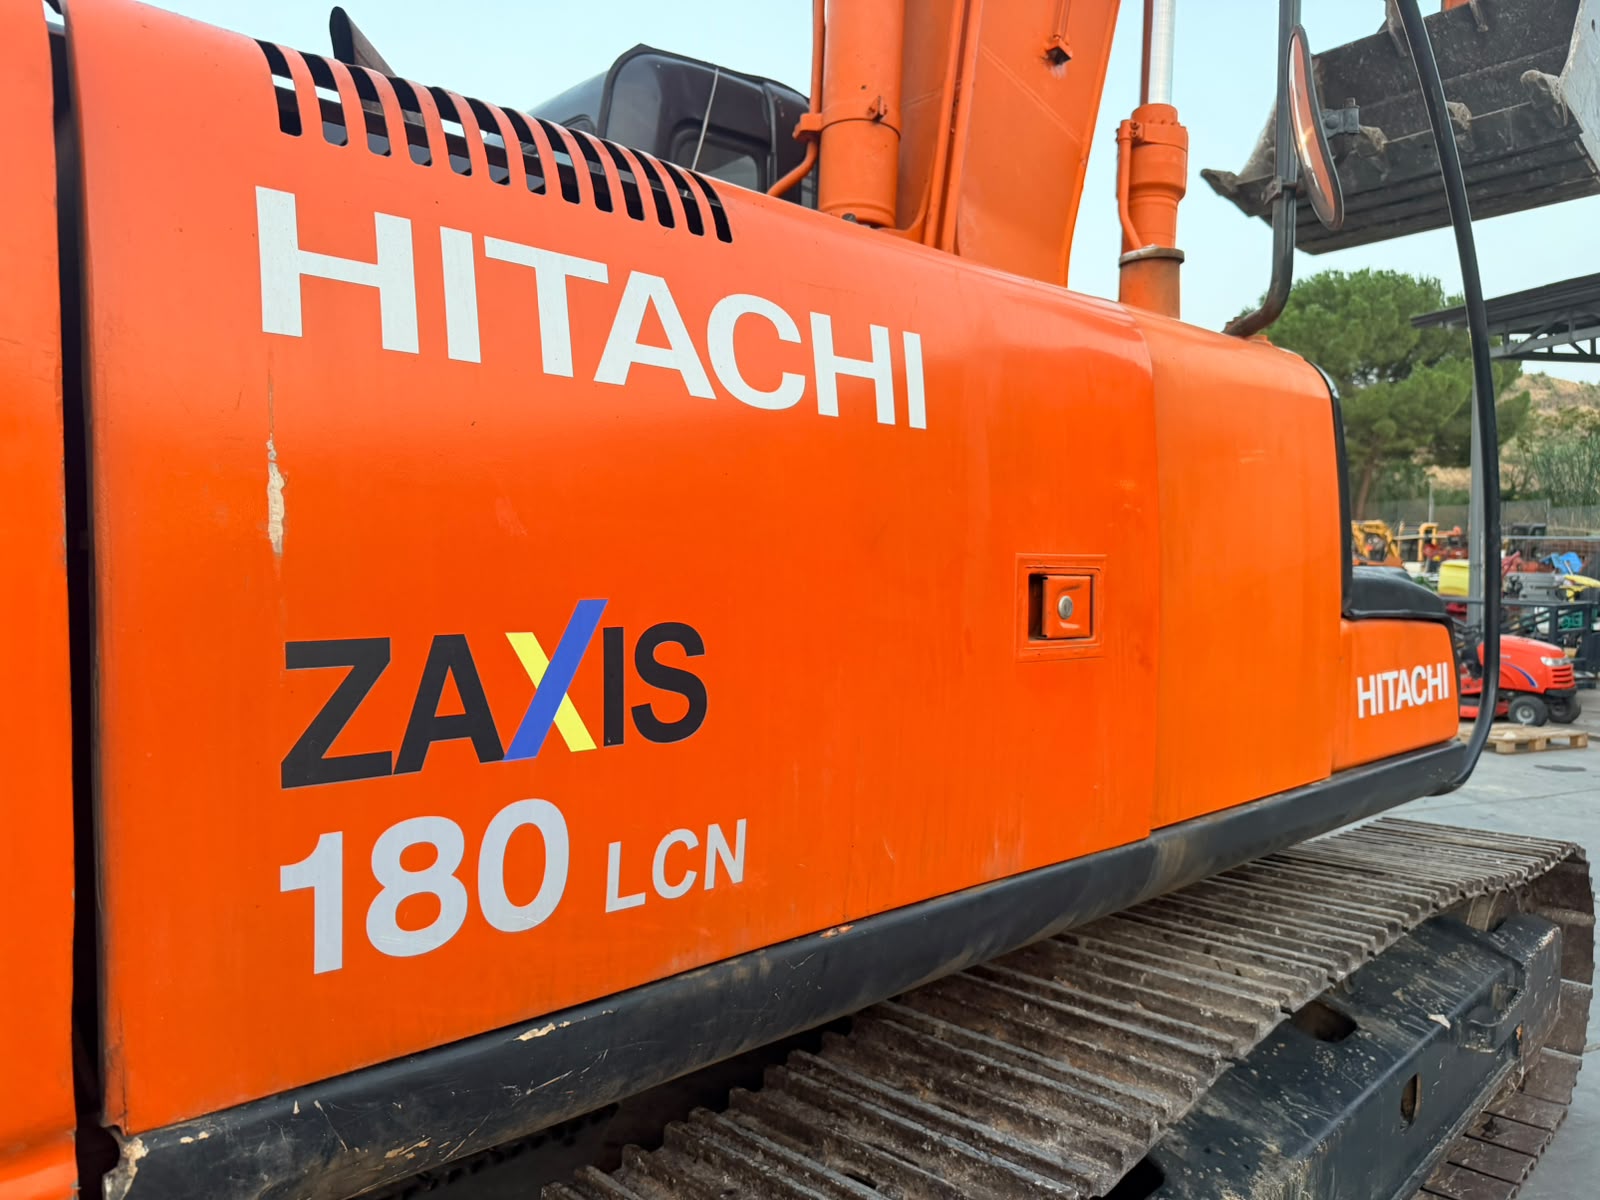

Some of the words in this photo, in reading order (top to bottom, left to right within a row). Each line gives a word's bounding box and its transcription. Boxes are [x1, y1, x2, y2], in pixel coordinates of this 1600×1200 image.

[255, 186, 927, 430] HITACHI
[281, 598, 708, 789] ZAXIS
[1357, 662, 1450, 719] HITACHI
[280, 798, 570, 975] 180
[605, 818, 747, 913] LCN
